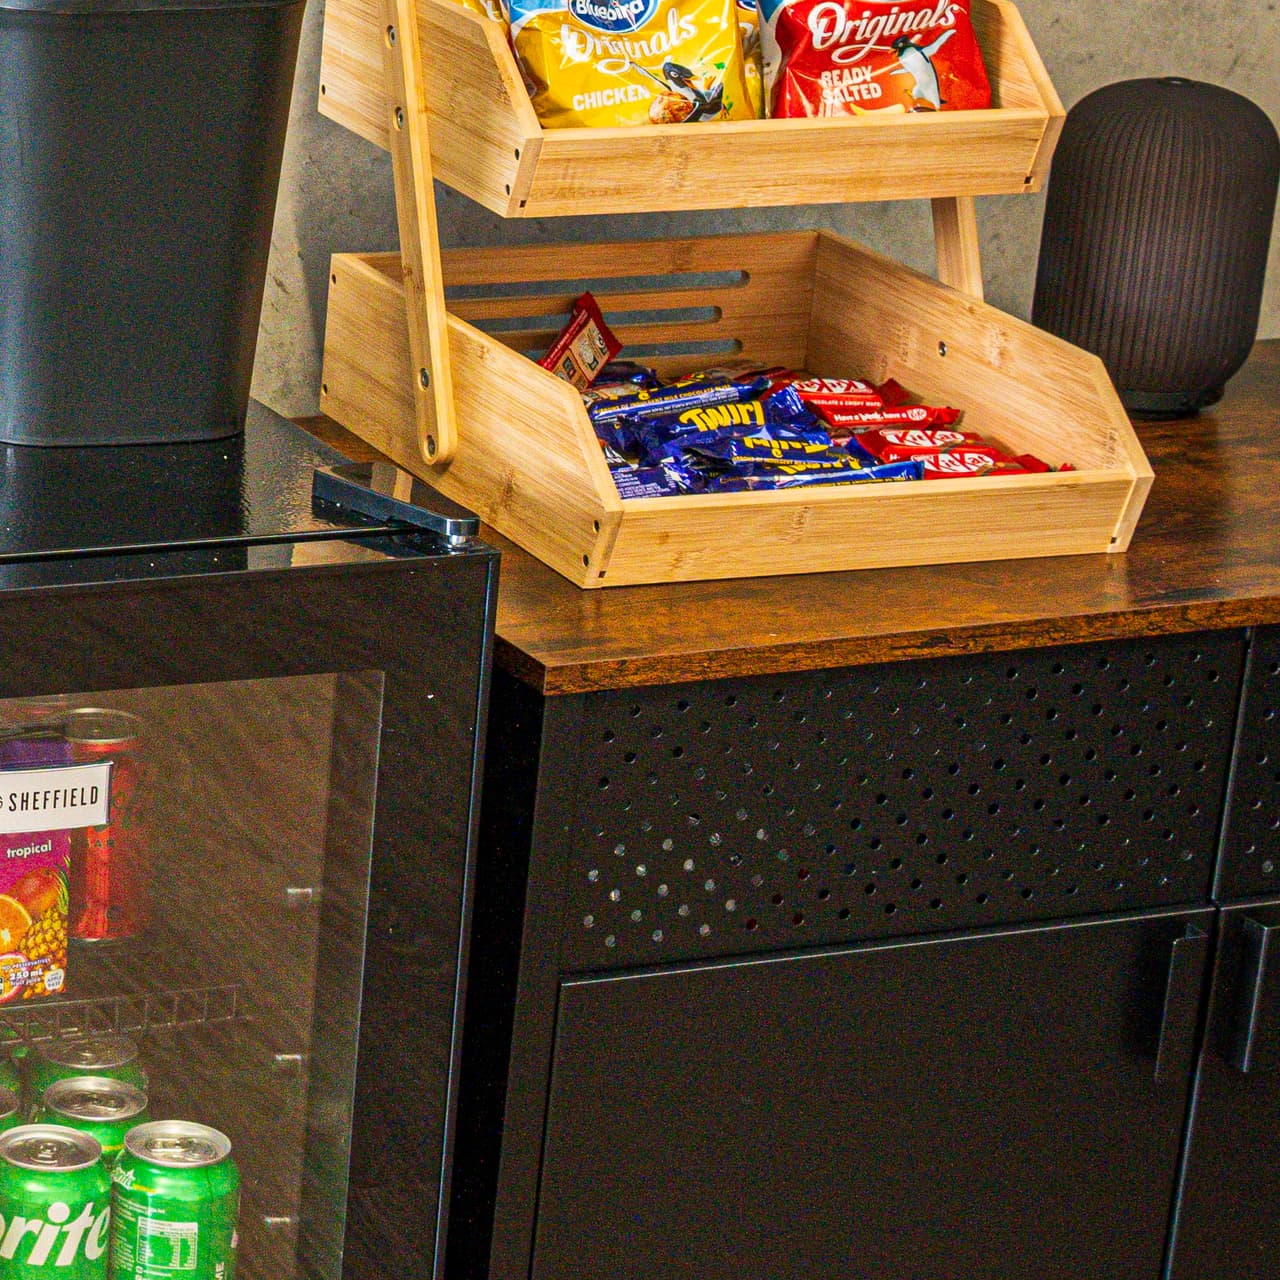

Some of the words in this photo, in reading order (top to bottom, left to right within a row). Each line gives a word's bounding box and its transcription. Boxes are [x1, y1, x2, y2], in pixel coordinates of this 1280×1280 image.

[559, 8, 699, 74] Originals
[821, 66, 875, 89] READY
[572, 84, 651, 111] CHICKEN
[822, 83, 882, 105] SALTED
[8, 785, 99, 812] SHEFFIELD
[6, 839, 53, 859] tropical
[9, 970, 29, 981] 250
